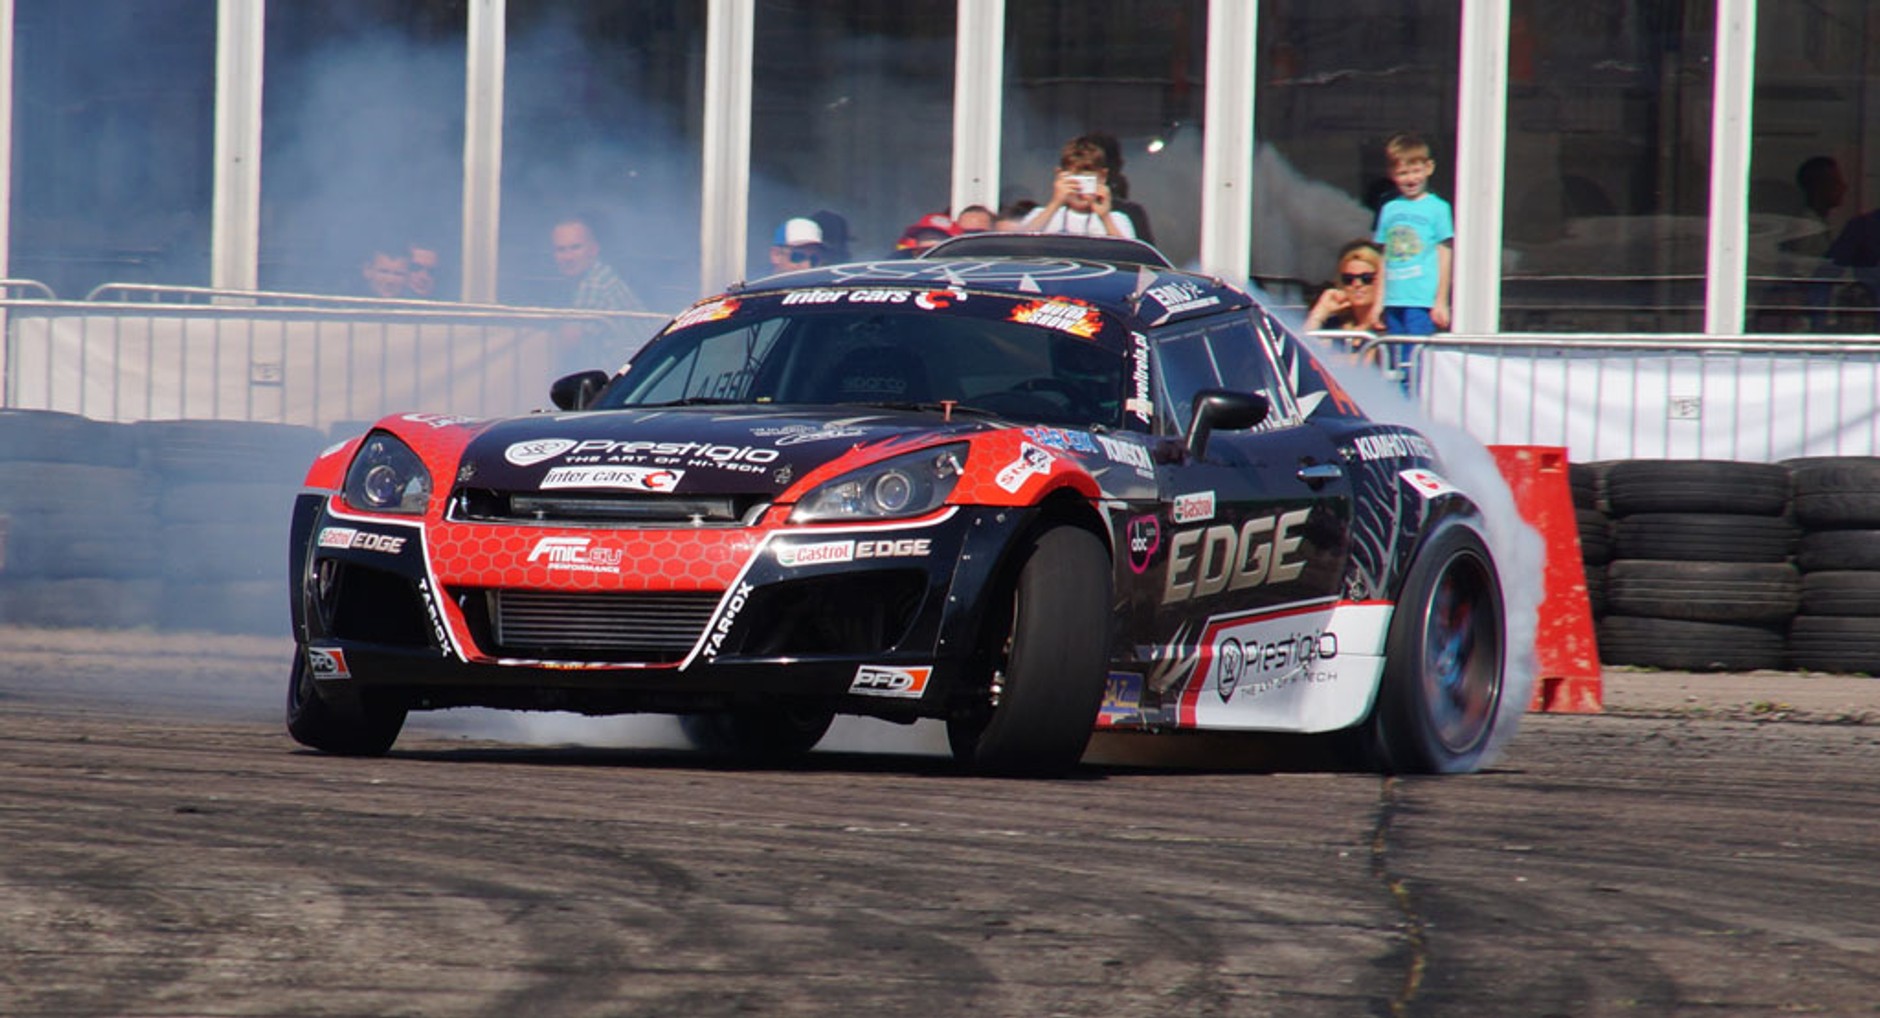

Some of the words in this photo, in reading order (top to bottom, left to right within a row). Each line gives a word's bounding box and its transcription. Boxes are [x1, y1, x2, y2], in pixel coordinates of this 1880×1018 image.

[781, 289, 848, 305] inter
[848, 289, 911, 303] cars
[572, 438, 780, 463] Prestigio
[545, 470, 591, 483] inter
[592, 471, 637, 483] cars
[564, 455, 601, 464] THE
[607, 455, 648, 463] ART
[654, 457, 681, 465] OF
[687, 459, 767, 474] HI-TECH
[351, 531, 407, 554] EDGE
[796, 543, 851, 563] Castrol
[855, 538, 932, 559] EDGE
[1160, 506, 1313, 604] EDGE
[1243, 628, 1339, 677] Prestigio
